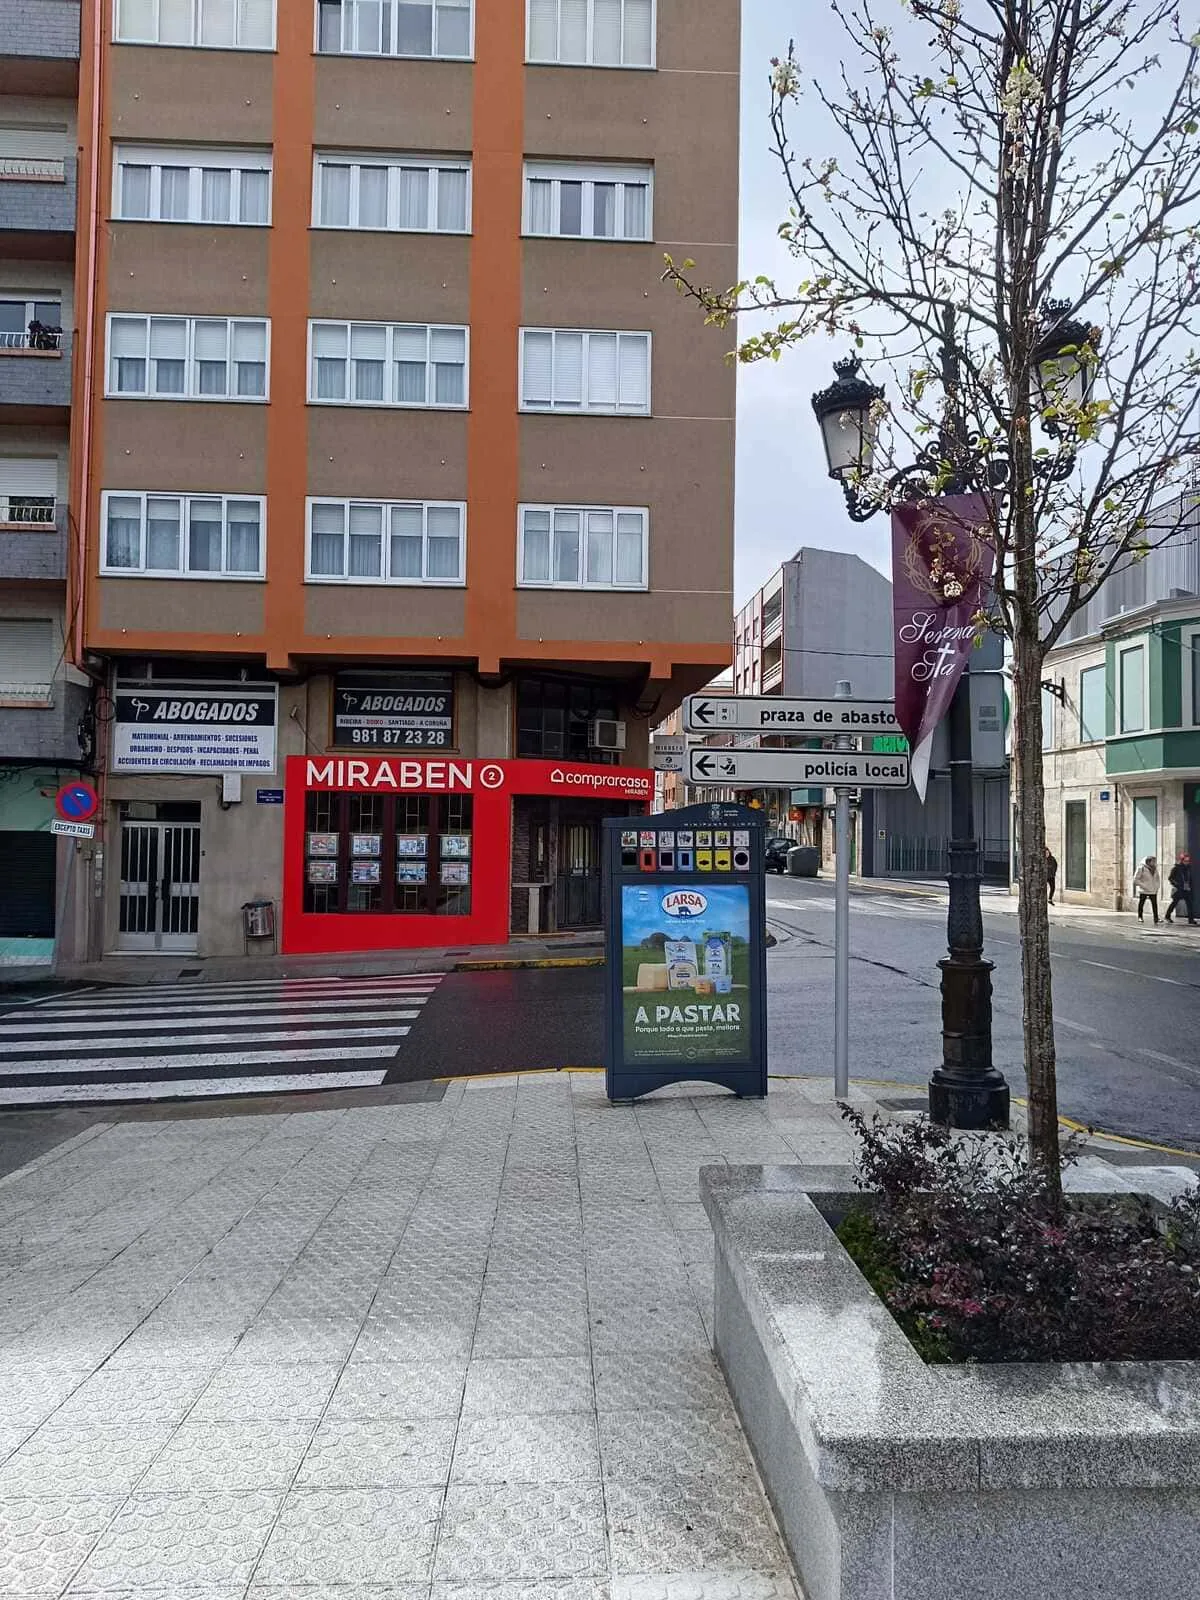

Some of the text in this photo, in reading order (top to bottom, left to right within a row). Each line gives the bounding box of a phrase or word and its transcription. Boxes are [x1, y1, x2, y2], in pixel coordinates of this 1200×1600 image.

[153, 701, 260, 721] ABOGADOS
[360, 695, 447, 712] ABOGADOS
[760, 709, 898, 724] praza de abasto
[132, 732, 258, 742] MATRIMONIAL ARRENDAMIENTOS SUCESIONES
[352, 729, 445, 745] 981 87 23 28
[130, 745, 259, 755] URBANISMO DESPIDOS INCAPACIDADES PENAL
[118, 757, 151, 765] ACCIDENTES
[160, 757, 196, 766] CIRCULACIÓN
[200, 758, 237, 767] RECLAMACIÓN
[239, 759, 245, 767] DE
[246, 759, 271, 767] IMPAGOS
[804, 761, 906, 778] policía local
[306, 759, 472, 789] MIRABEN
[624, 788, 649, 796] MIRABEN
[54, 823, 77, 833] EXCEPTO
[666, 893, 703, 909] LARSA
[634, 1003, 741, 1023] A PASTAR
